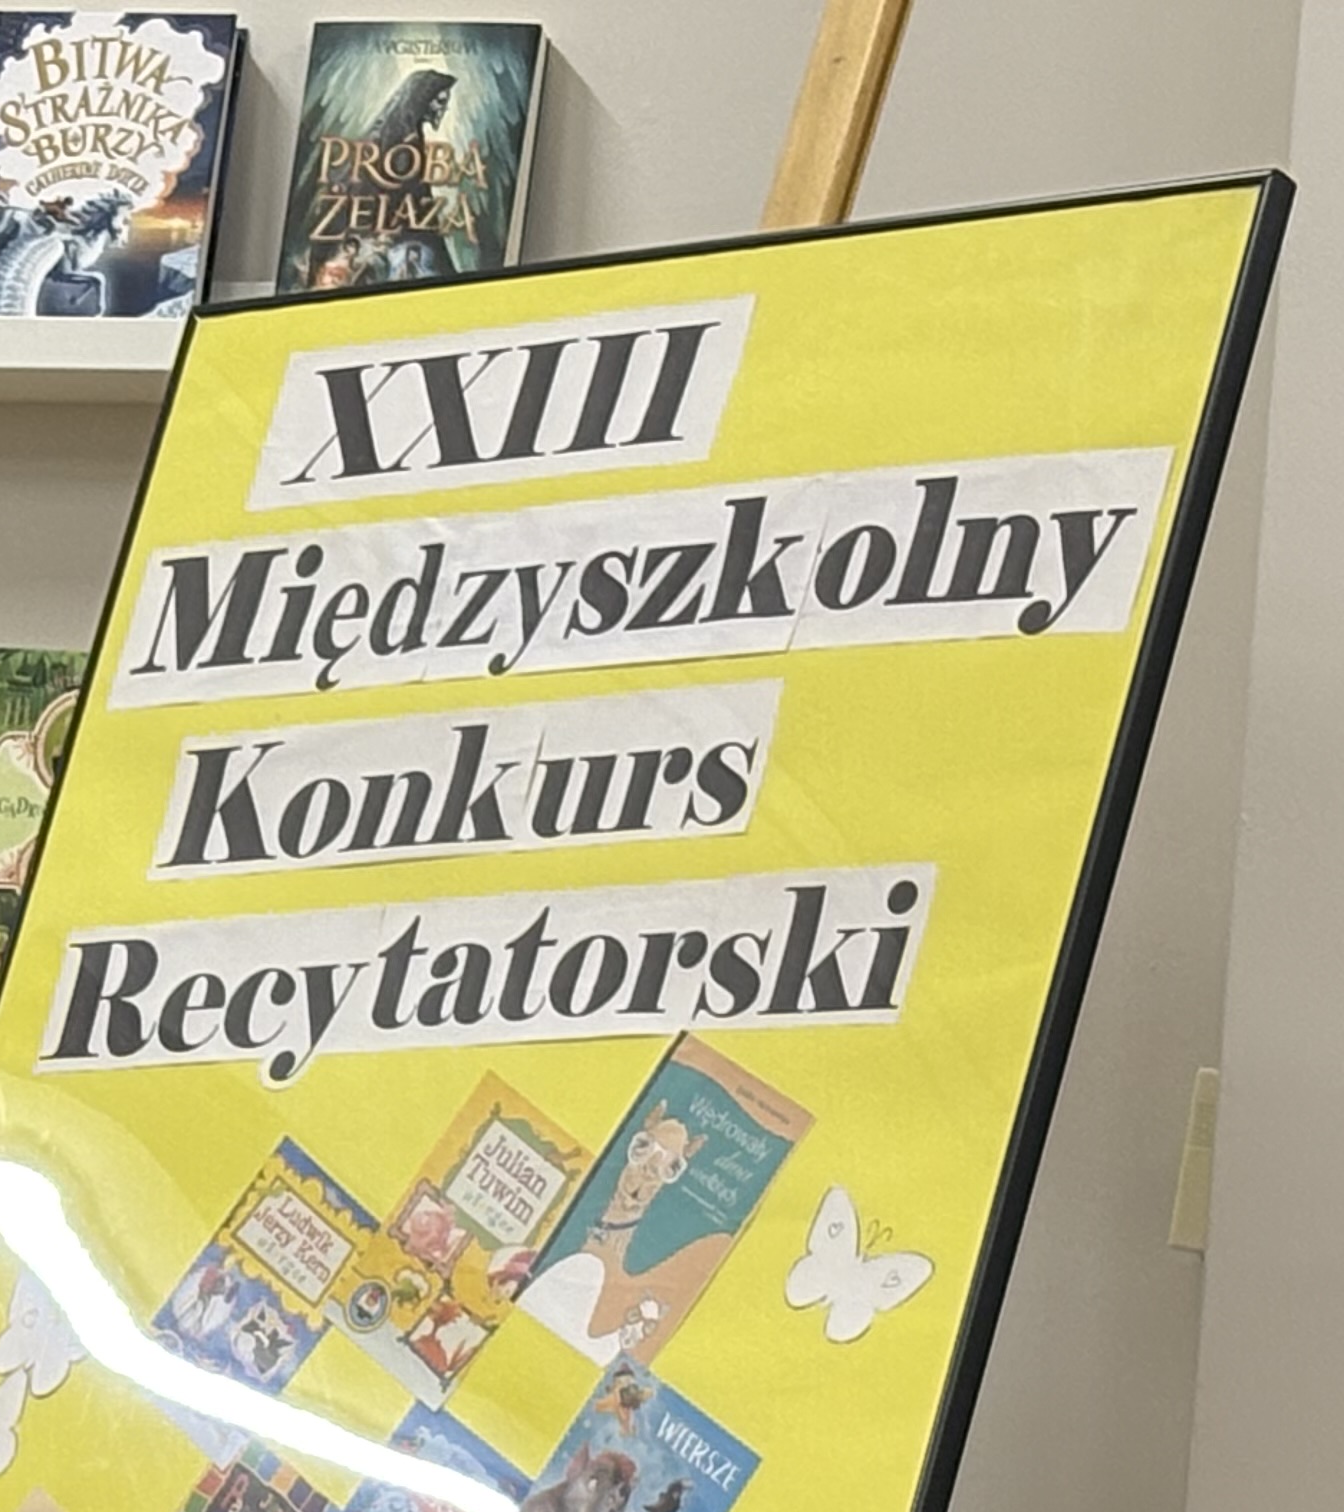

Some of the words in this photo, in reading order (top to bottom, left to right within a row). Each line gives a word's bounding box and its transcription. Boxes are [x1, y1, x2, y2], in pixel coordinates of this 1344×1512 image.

[28, 30, 193, 95] BITWA
[0, 82, 198, 147] STRAŻNIKA
[21, 122, 165, 166] BURZY
[316, 132, 489, 190] PRÓBA
[309, 182, 479, 245] ŻELAZA
[280, 321, 720, 486] XXIII
[130, 476, 1139, 690] Międzyszkolny
[155, 723, 762, 868] Konkurs
[36, 878, 921, 1083] Recytatorski
[466, 1151, 535, 1227] Tuwim
[483, 1134, 548, 1200] Julian
[656, 1411, 742, 1492] WIERSZE
